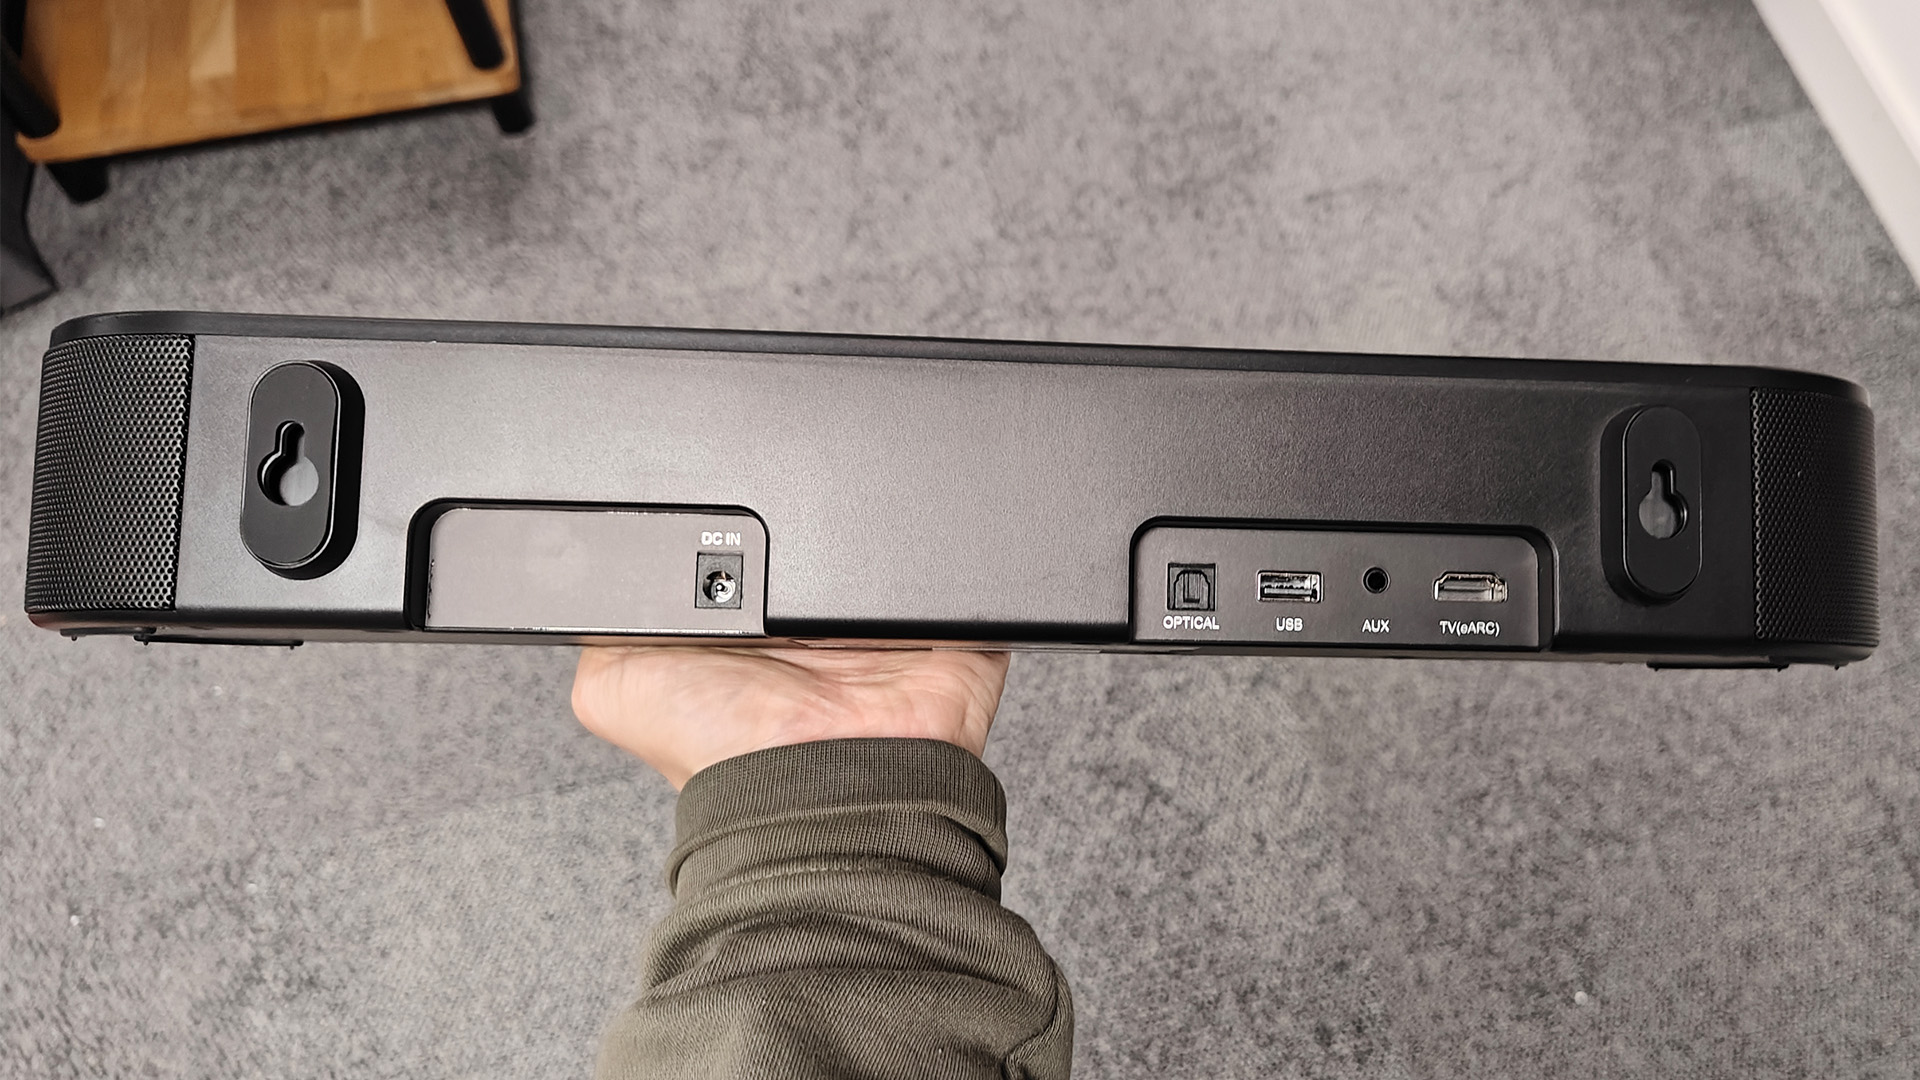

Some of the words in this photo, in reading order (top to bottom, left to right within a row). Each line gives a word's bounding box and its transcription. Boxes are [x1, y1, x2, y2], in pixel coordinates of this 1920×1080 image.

[701, 531, 723, 546] DC
[726, 532, 741, 546] IN
[1162, 615, 1220, 630] OPTICAL
[1276, 617, 1303, 631] USB
[1362, 618, 1390, 633] AUX
[1440, 620, 1500, 636] TV(eARC)
